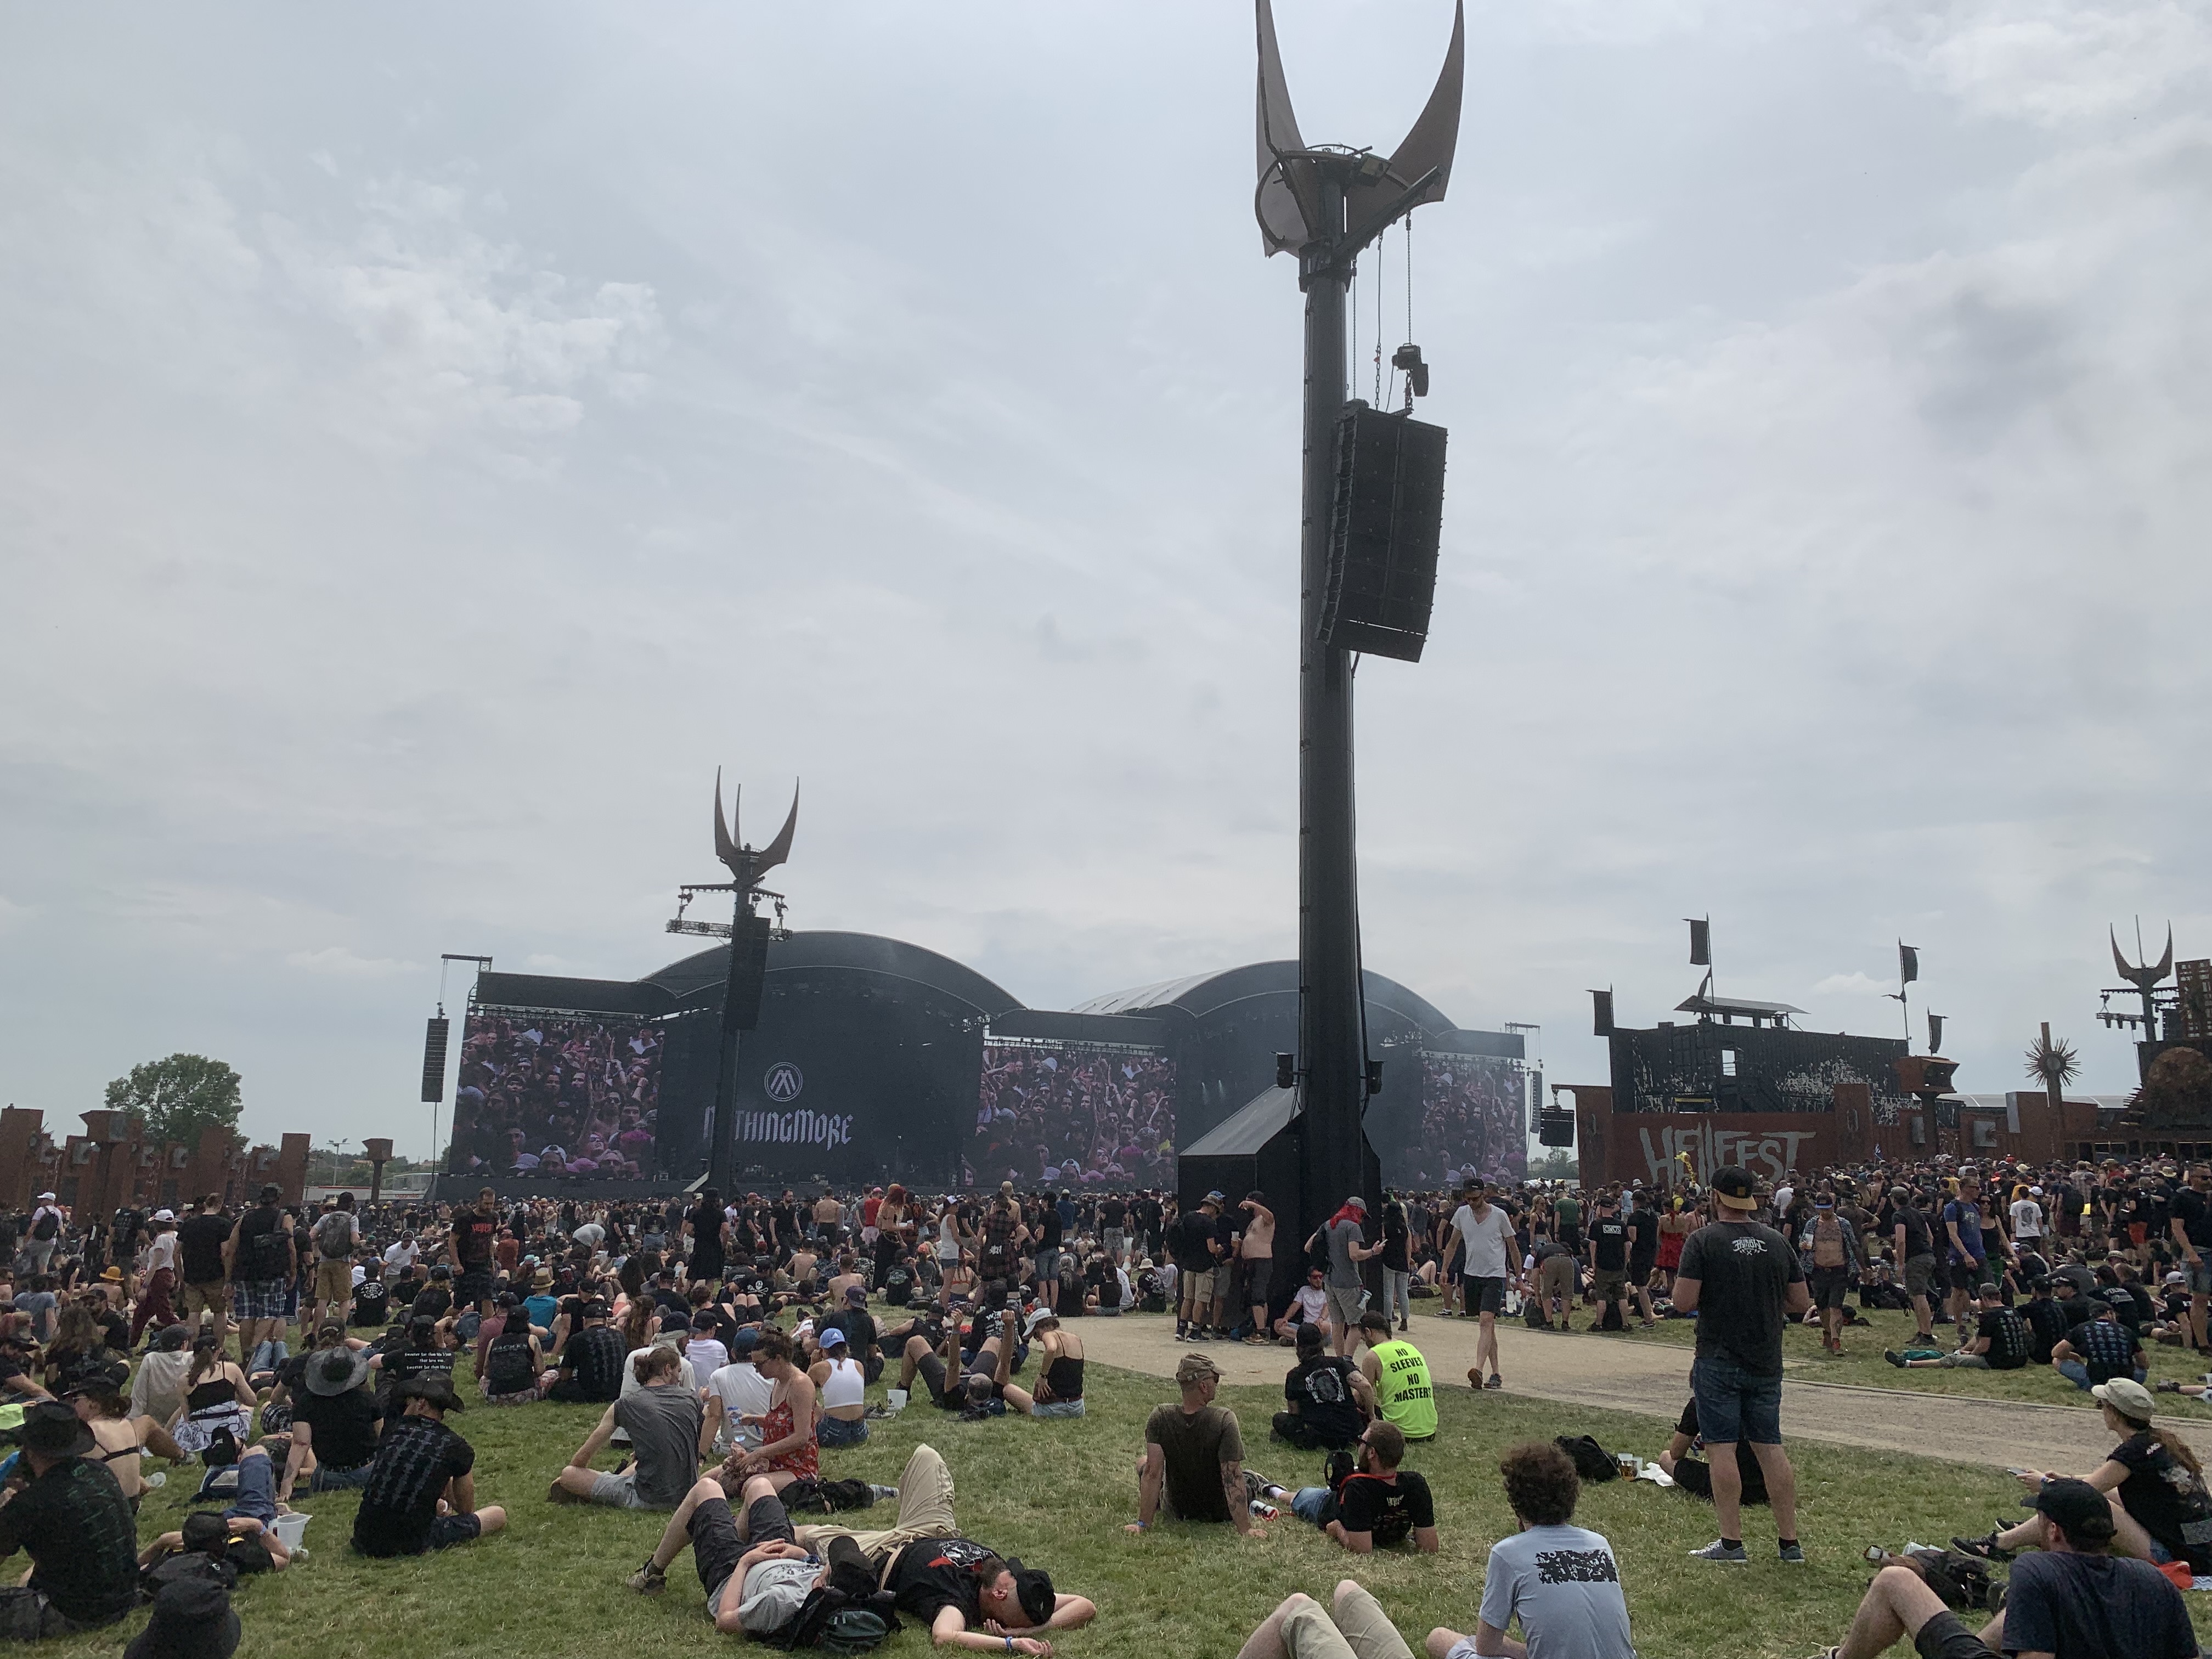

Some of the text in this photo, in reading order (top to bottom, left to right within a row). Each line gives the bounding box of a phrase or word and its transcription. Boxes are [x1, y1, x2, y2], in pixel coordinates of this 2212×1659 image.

[1639, 1119, 1816, 1194] HELLFEST
[1395, 1348, 1408, 1357] NO
[1390, 1356, 1423, 1373] SLEEVES
[1407, 1373, 1419, 1385] NO
[1394, 1386, 1431, 1402] MASTERS
